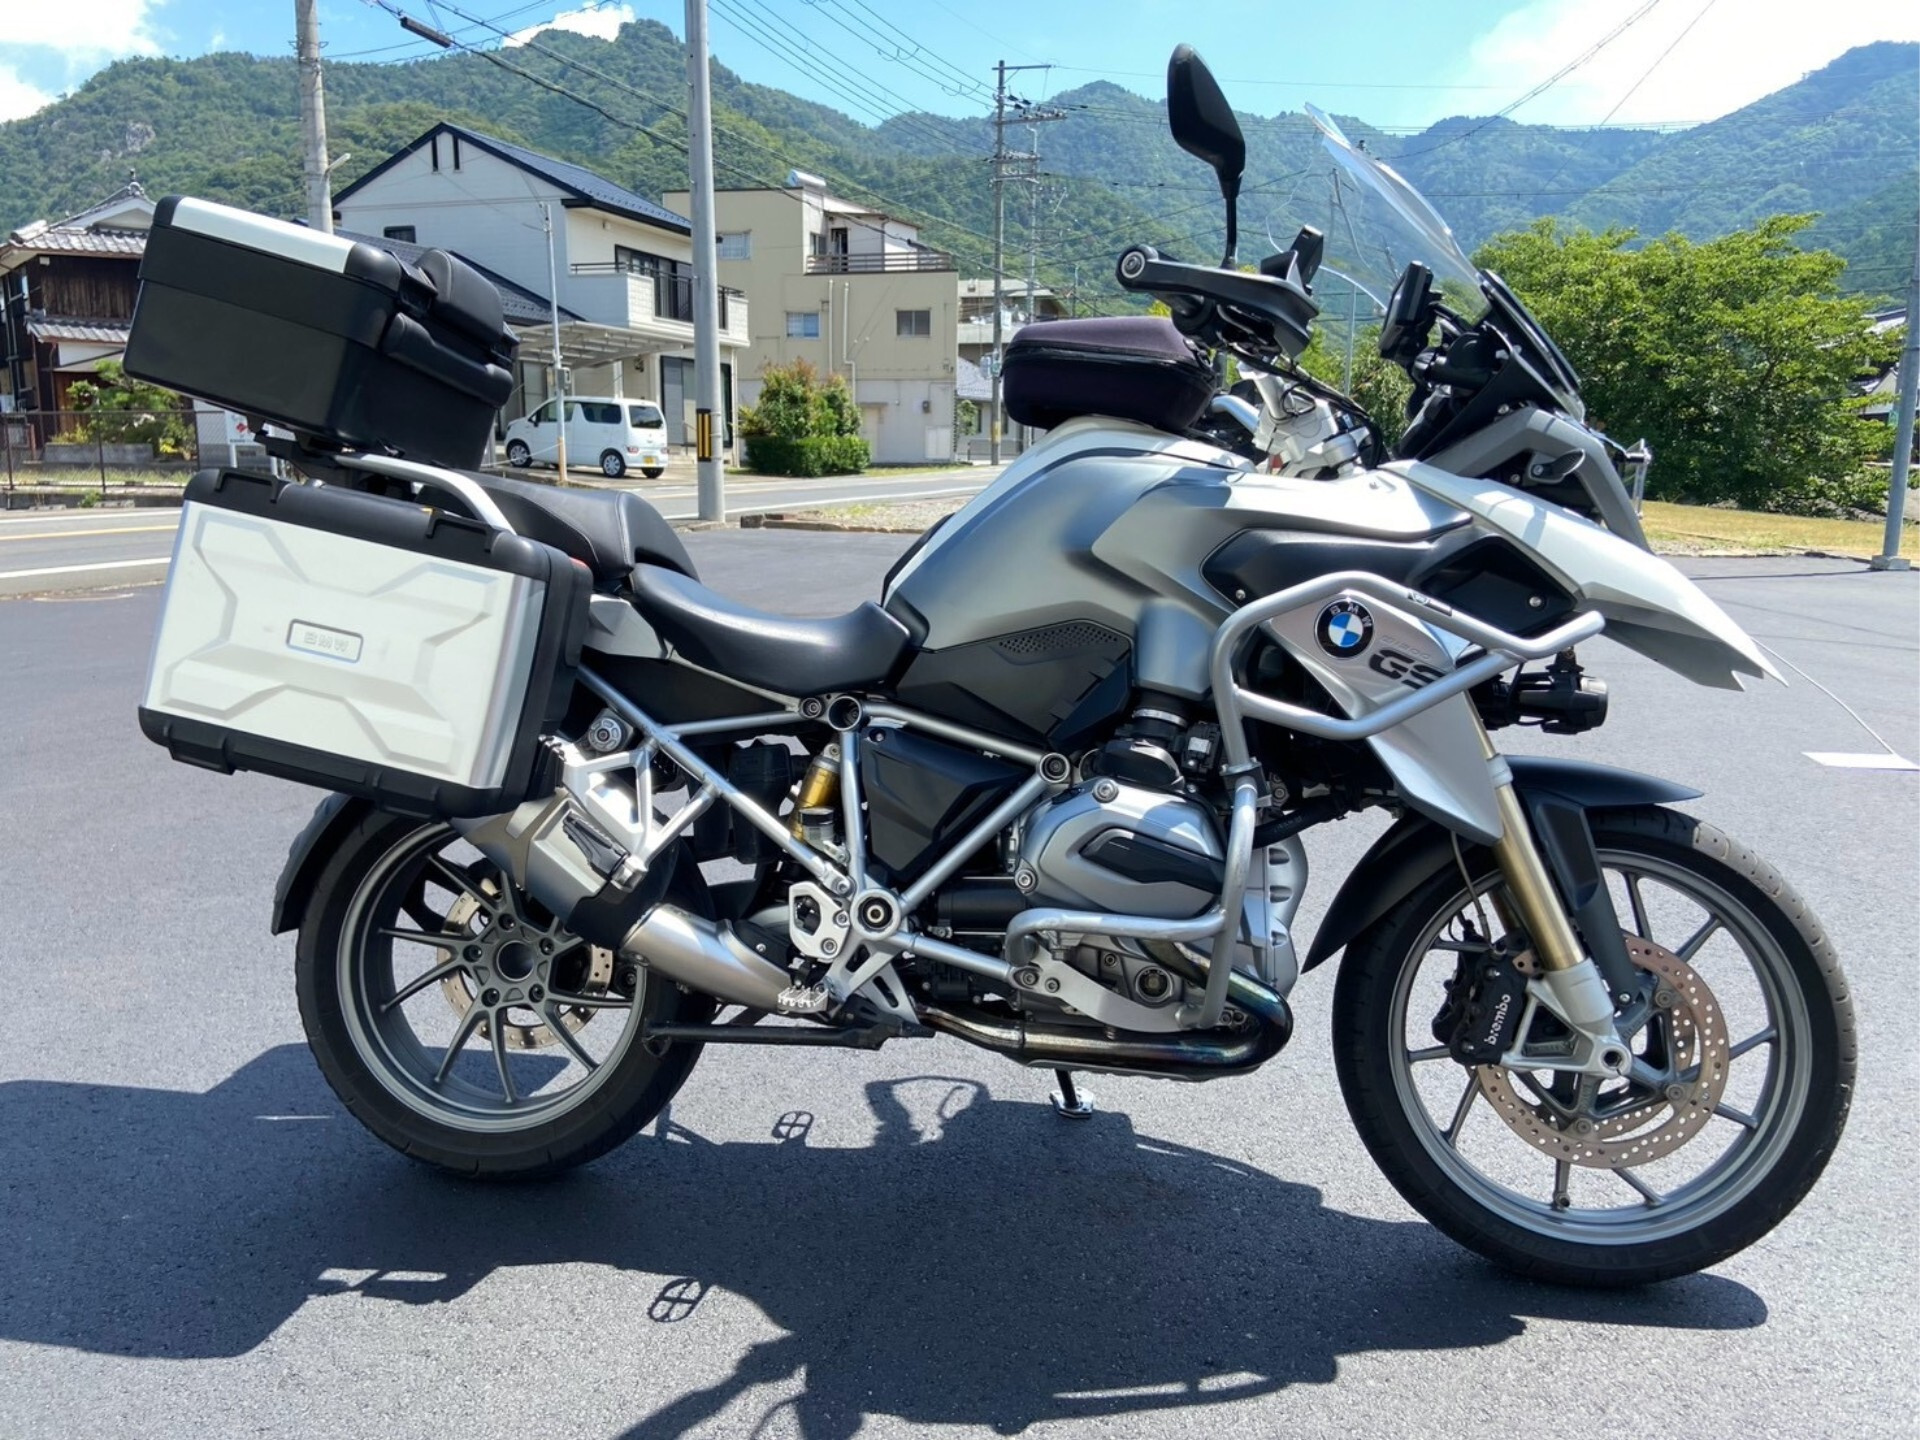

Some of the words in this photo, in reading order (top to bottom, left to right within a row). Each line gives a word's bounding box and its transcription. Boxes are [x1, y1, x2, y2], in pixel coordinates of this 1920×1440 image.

[1330, 604, 1372, 628] BMW
[1369, 650, 1446, 690] GS
[1483, 994, 1511, 1046] brembo
